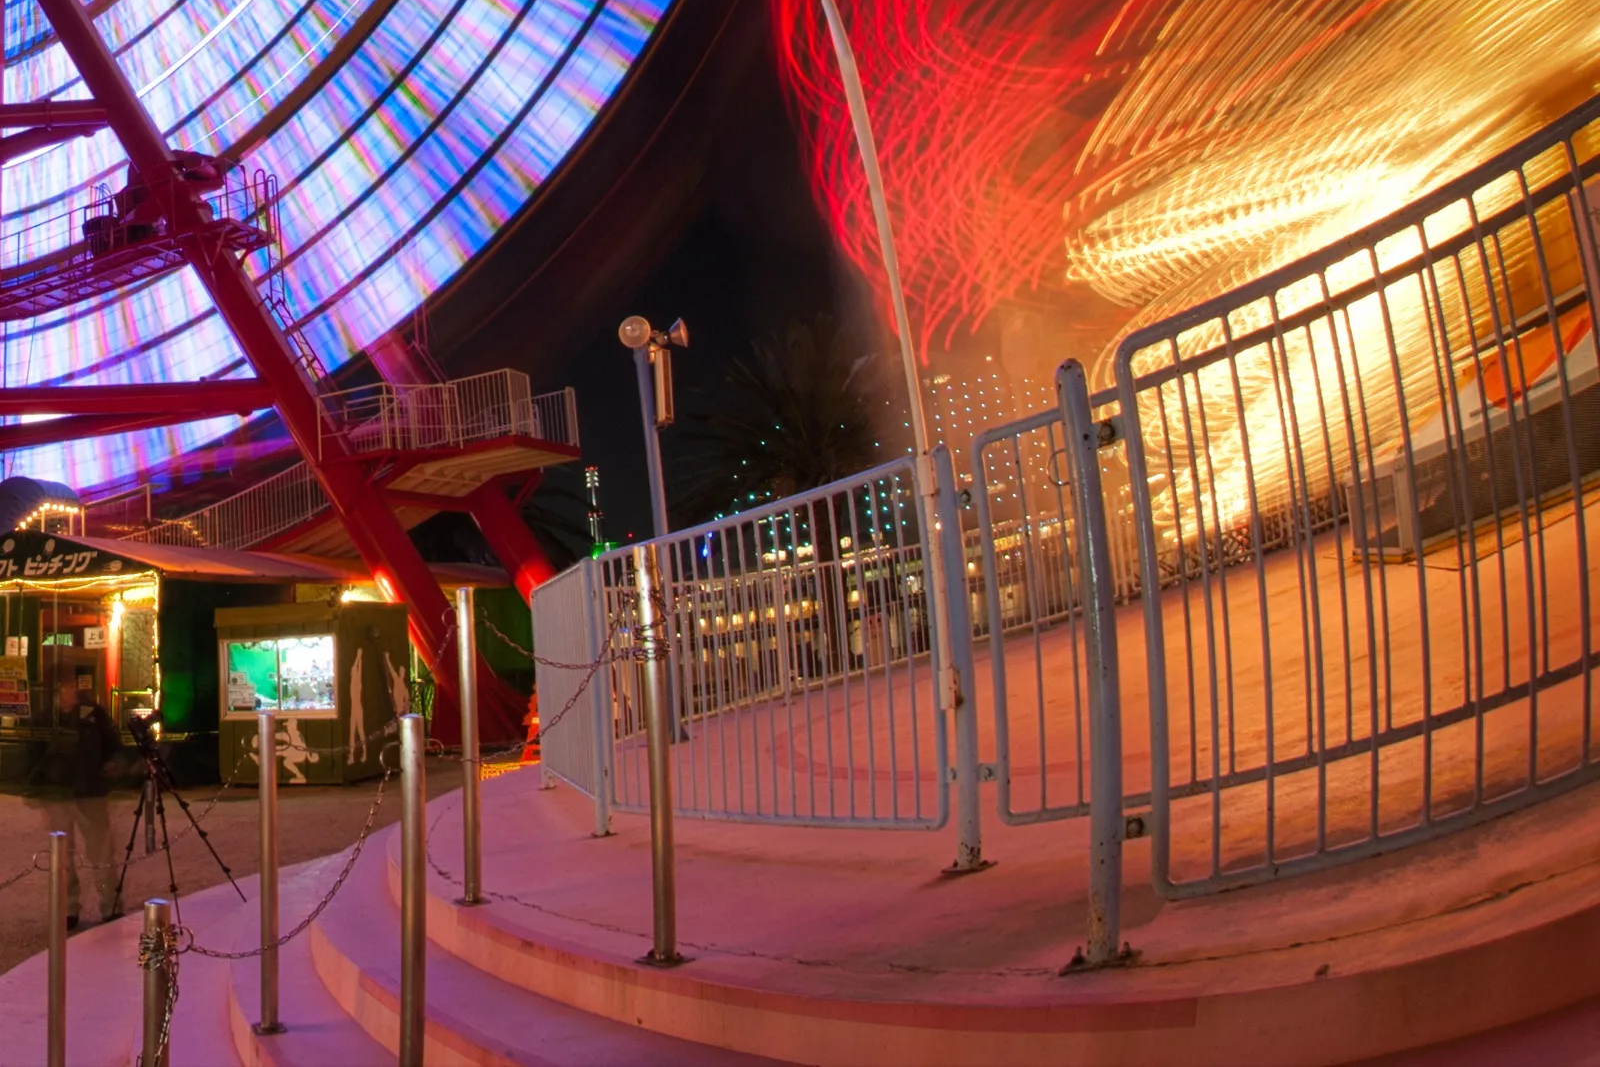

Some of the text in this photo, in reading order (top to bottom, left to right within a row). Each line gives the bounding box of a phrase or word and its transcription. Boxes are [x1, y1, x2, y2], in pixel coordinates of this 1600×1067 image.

[24, 551, 98, 576] ピッチング
